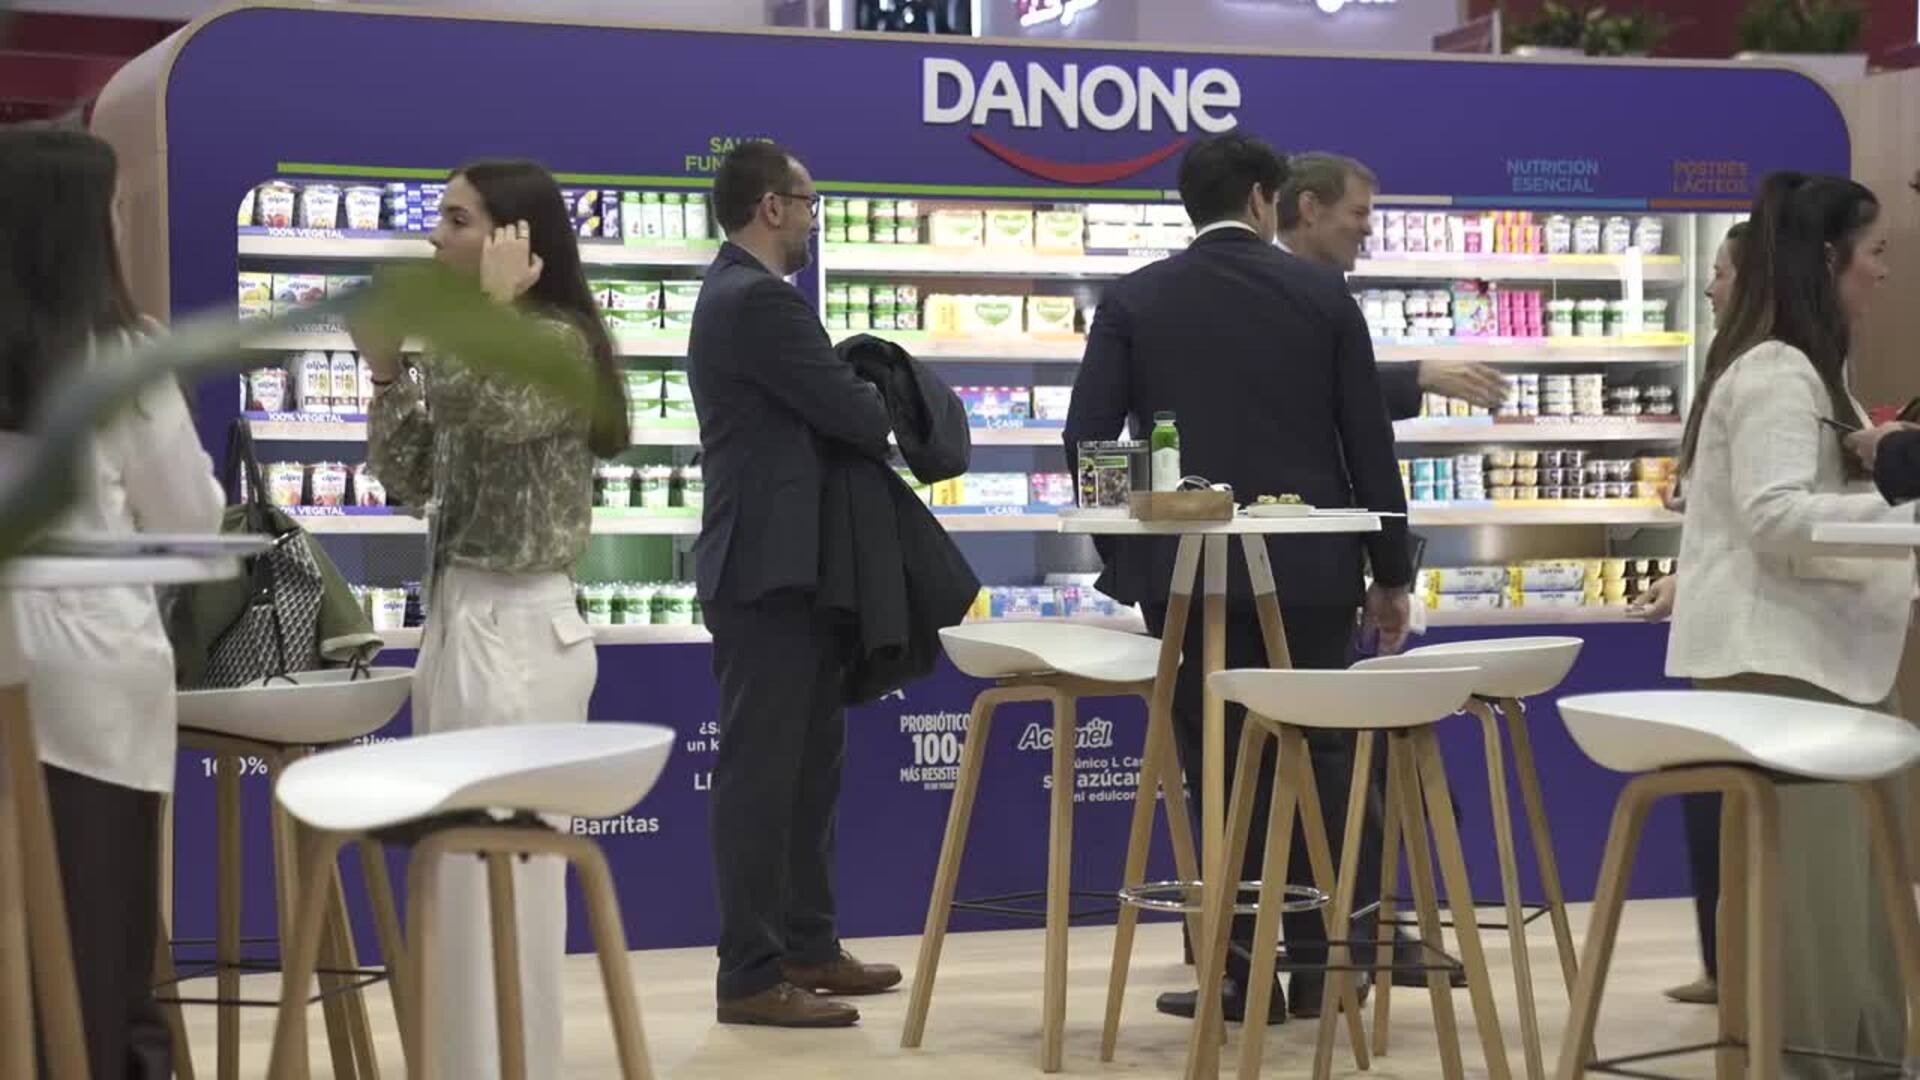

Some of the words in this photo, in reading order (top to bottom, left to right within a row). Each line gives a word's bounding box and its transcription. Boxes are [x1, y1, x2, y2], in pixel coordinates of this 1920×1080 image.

[1512, 176, 1594, 192] ESENCIAL
[296, 229, 344, 239] VEGETAL
[297, 412, 344, 422] VEGETAL
[297, 506, 345, 516] VEGETAL
[687, 740, 706, 752] un
[573, 815, 660, 835] Barritas
